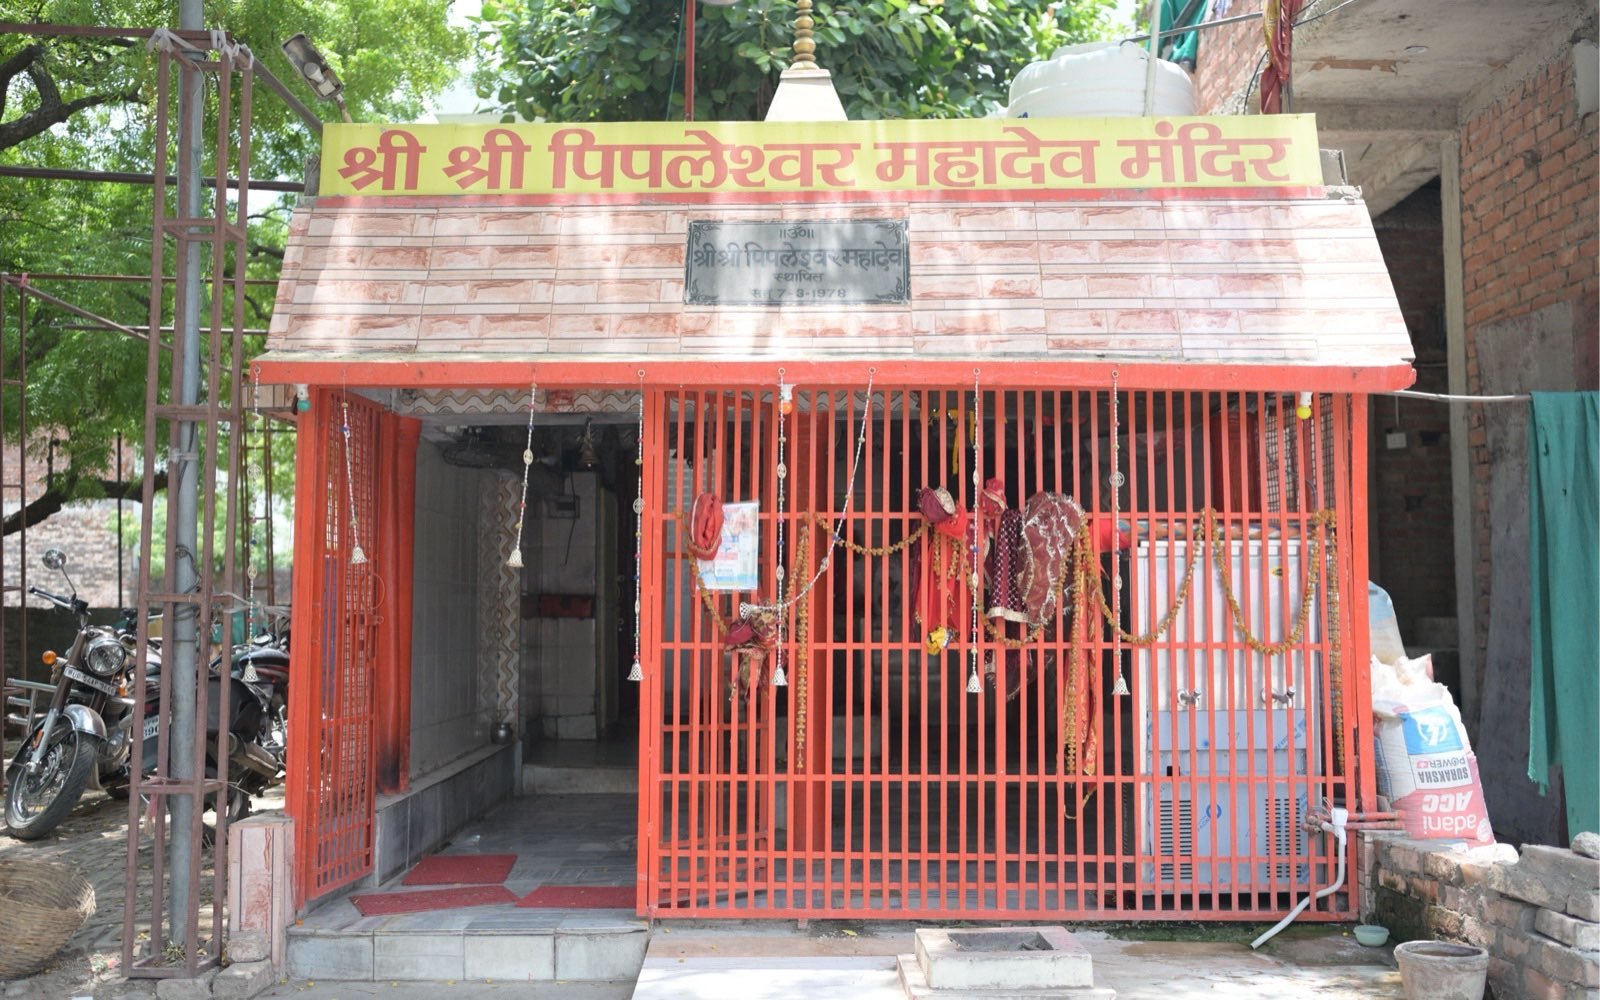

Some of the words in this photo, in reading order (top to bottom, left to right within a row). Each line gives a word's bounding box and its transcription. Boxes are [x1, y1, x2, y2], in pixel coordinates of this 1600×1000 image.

[337, 128, 428, 191] श्री
[441, 128, 532, 190] श्री
[547, 128, 862, 189] पिपलेश्वर
[873, 126, 1101, 188] महादेव
[1116, 121, 1292, 183] मंदिर
[693, 240, 716, 268] श्री
[717, 241, 742, 268] श्री
[1418, 767, 1469, 784] SURAKSHA
[1422, 790, 1473, 813] ACC
[1423, 814, 1475, 834] adani
